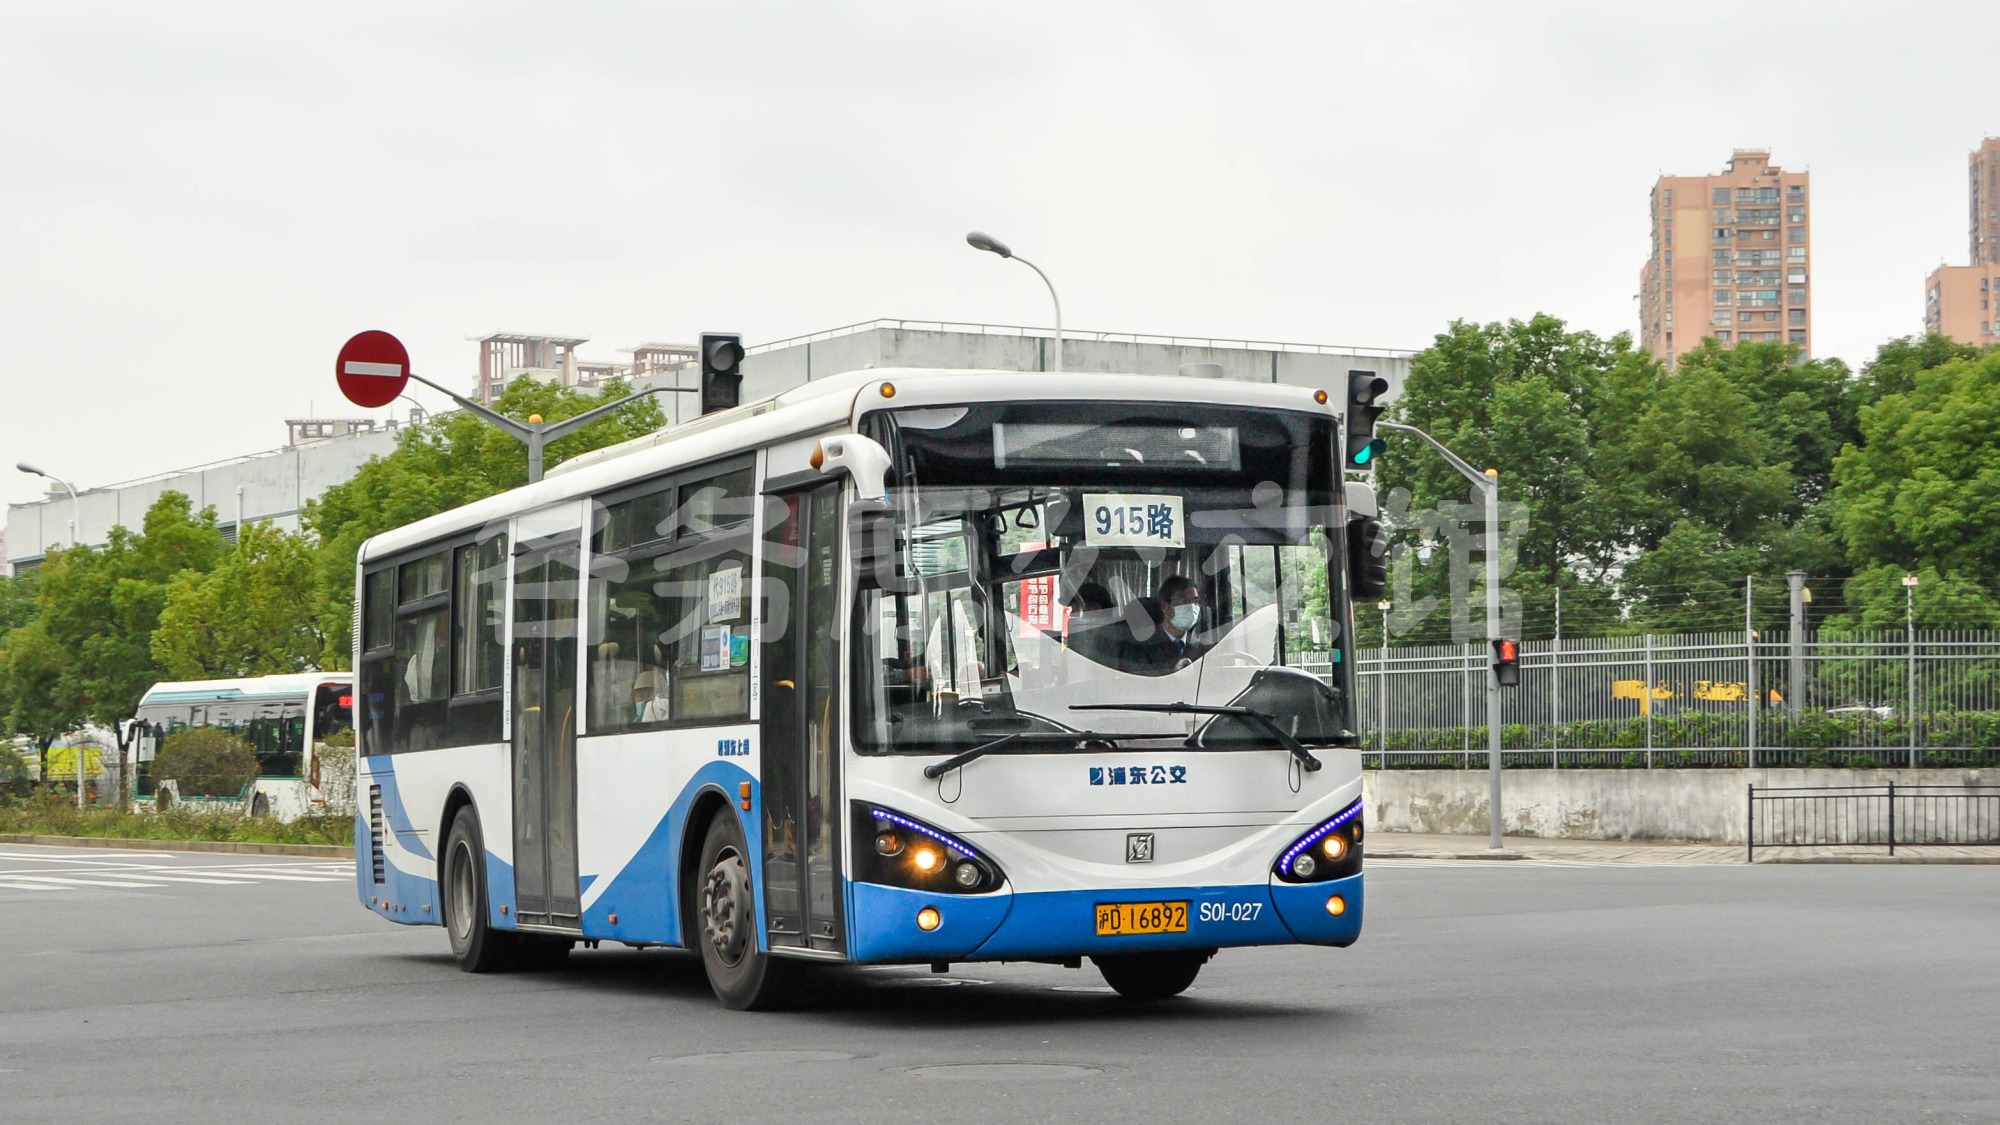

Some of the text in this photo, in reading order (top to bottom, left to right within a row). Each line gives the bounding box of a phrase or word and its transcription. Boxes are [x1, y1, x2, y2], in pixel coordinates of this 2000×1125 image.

[1095, 503, 1174, 539] 915路
[1108, 765, 1187, 786] 浦东公交
